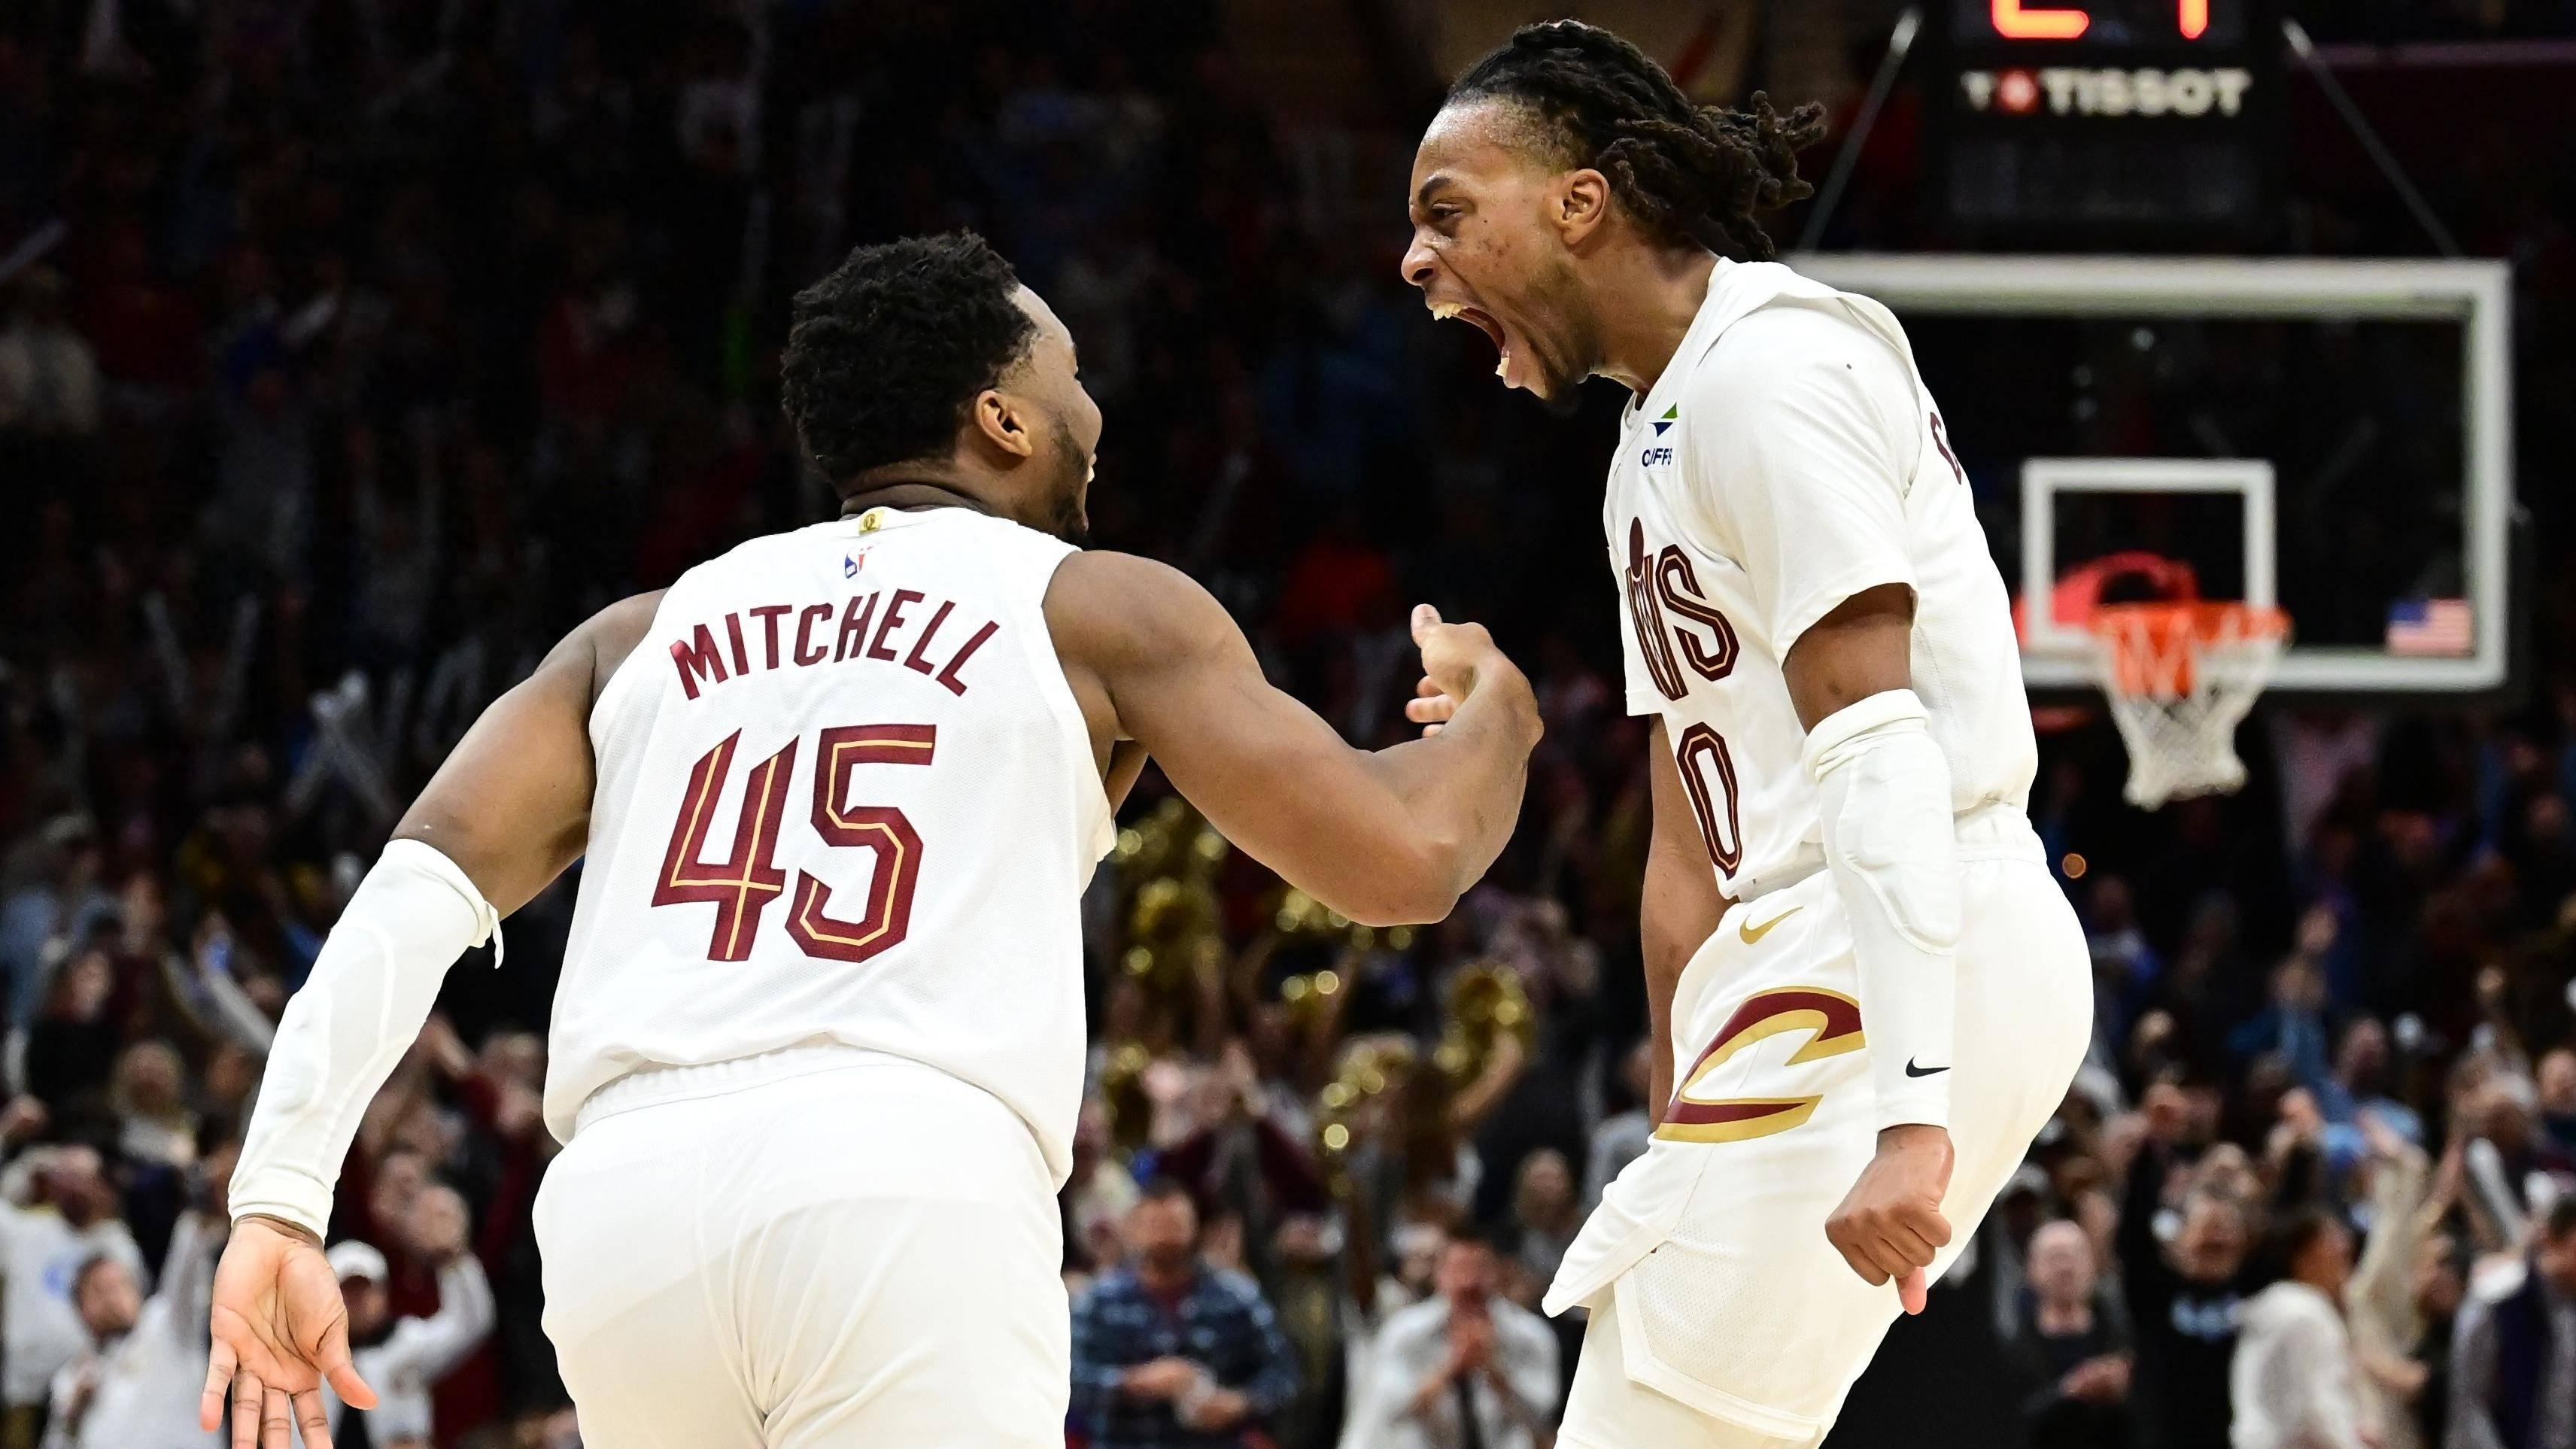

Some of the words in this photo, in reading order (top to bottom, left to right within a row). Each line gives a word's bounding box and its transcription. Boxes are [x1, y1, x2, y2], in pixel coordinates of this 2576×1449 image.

[2040, 67, 2252, 117] TISSOT
[669, 588, 1001, 701] MITCHELL
[651, 723, 937, 964] 45
[1676, 721, 1743, 881] 0
